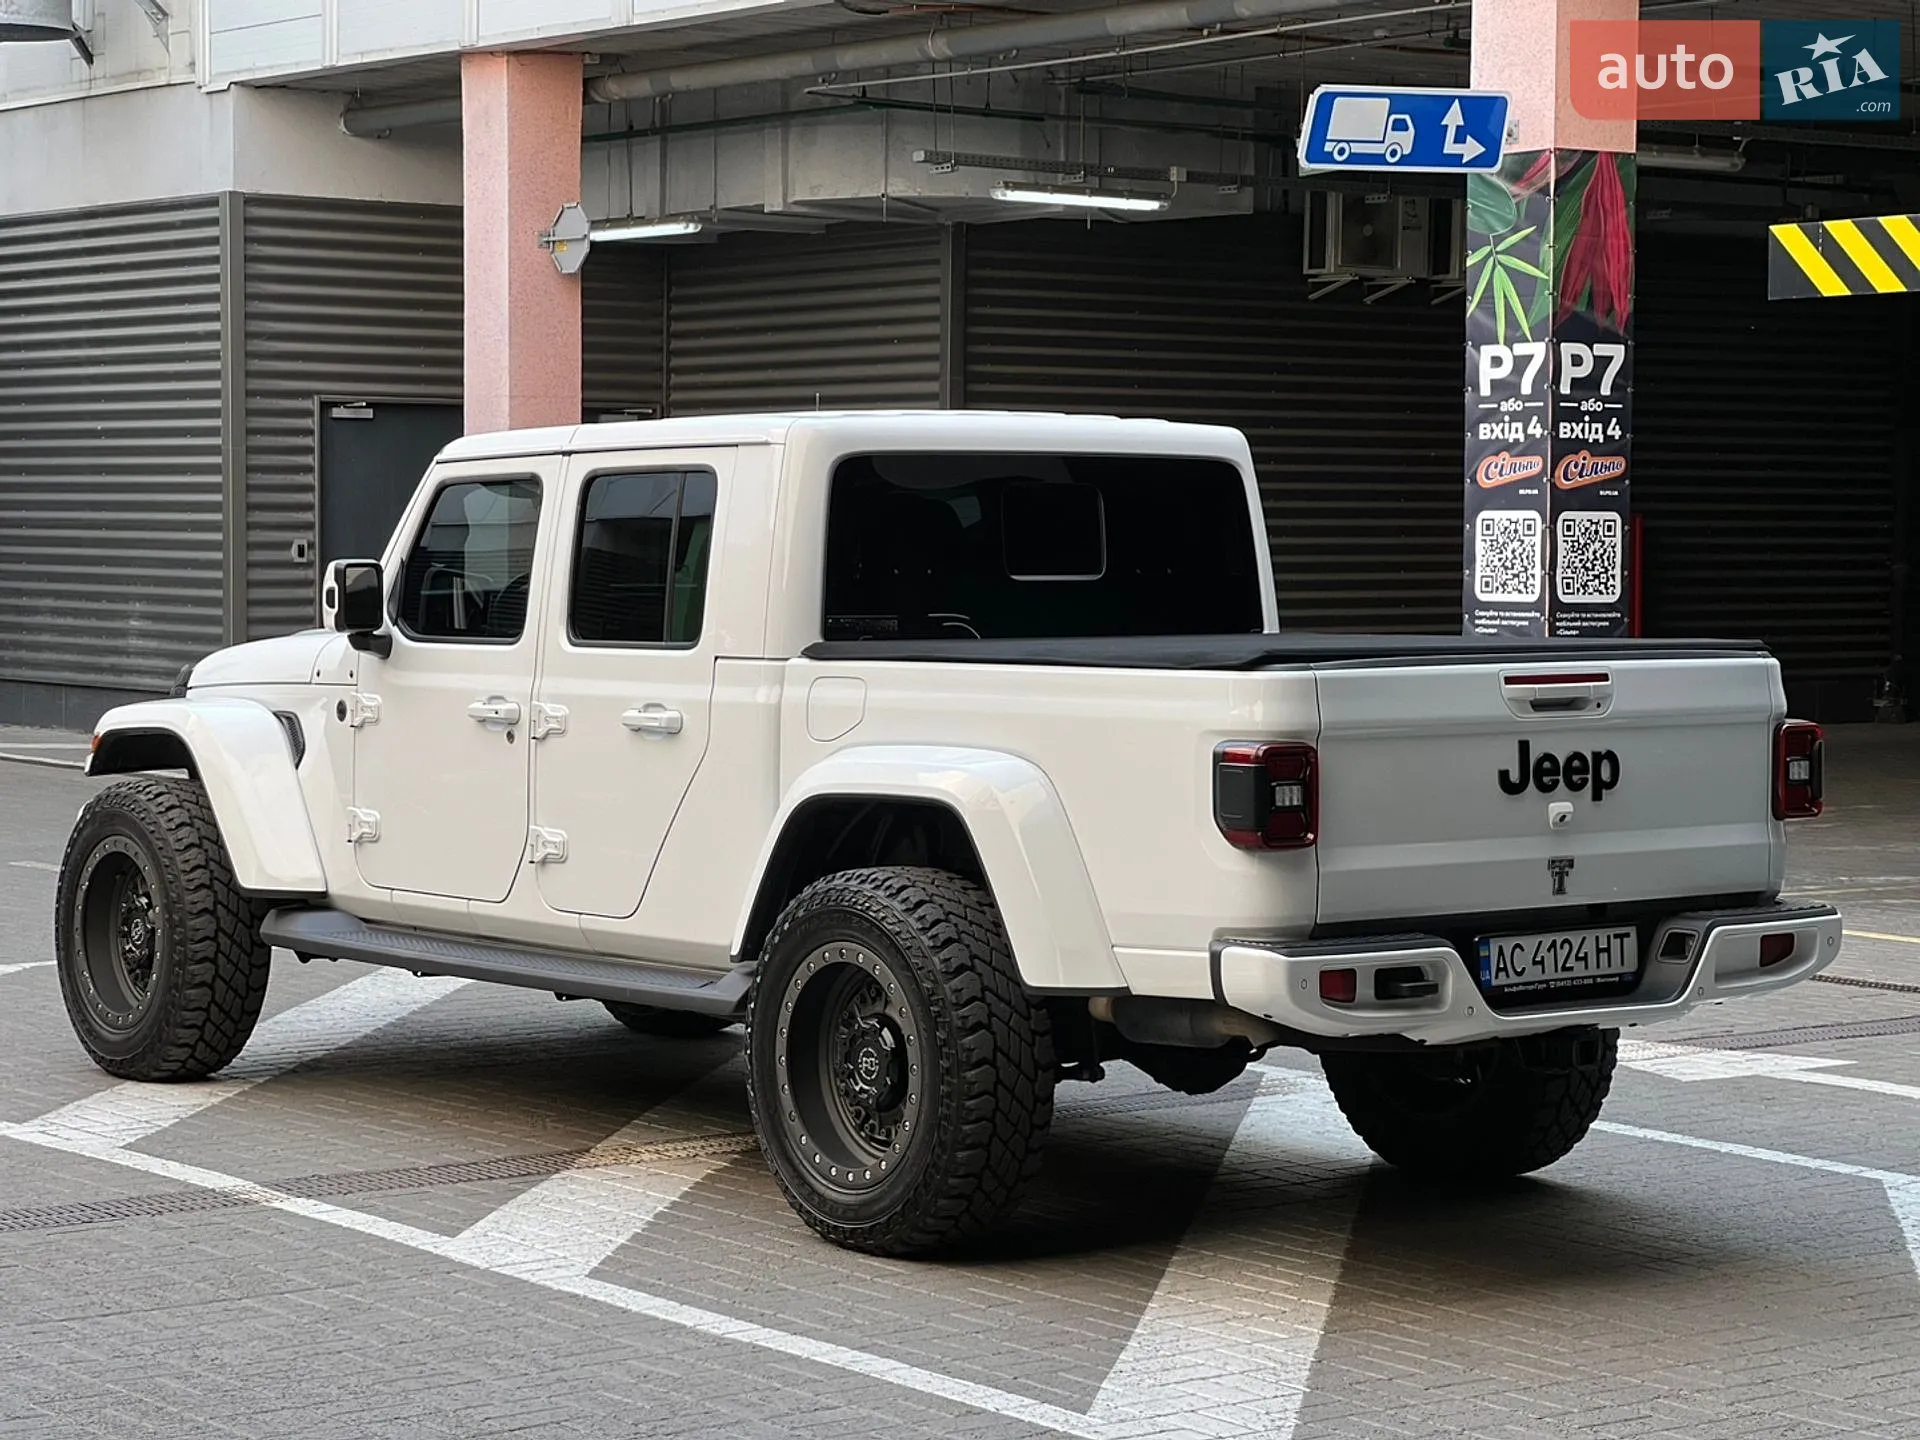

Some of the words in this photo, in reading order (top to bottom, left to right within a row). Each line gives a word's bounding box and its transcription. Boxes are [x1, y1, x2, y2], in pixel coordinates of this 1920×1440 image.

[1479, 342, 1546, 396] P7
[1560, 342, 1625, 396] P7
[1500, 398, 1523, 412] або
[1580, 398, 1603, 412] або
[1479, 415, 1525, 442] вхід
[1527, 415, 1543, 438] 4
[1559, 415, 1604, 443] вхід
[1607, 417, 1622, 440] 4
[1482, 455, 1541, 484] Сільпо
[1562, 454, 1623, 485] Сільпо
[1498, 739, 1620, 802] Jeep
[1495, 943, 1527, 980] AC
[1532, 936, 1589, 975] 4124
[1595, 932, 1631, 970] HT
[1480, 969, 1491, 982] UA
